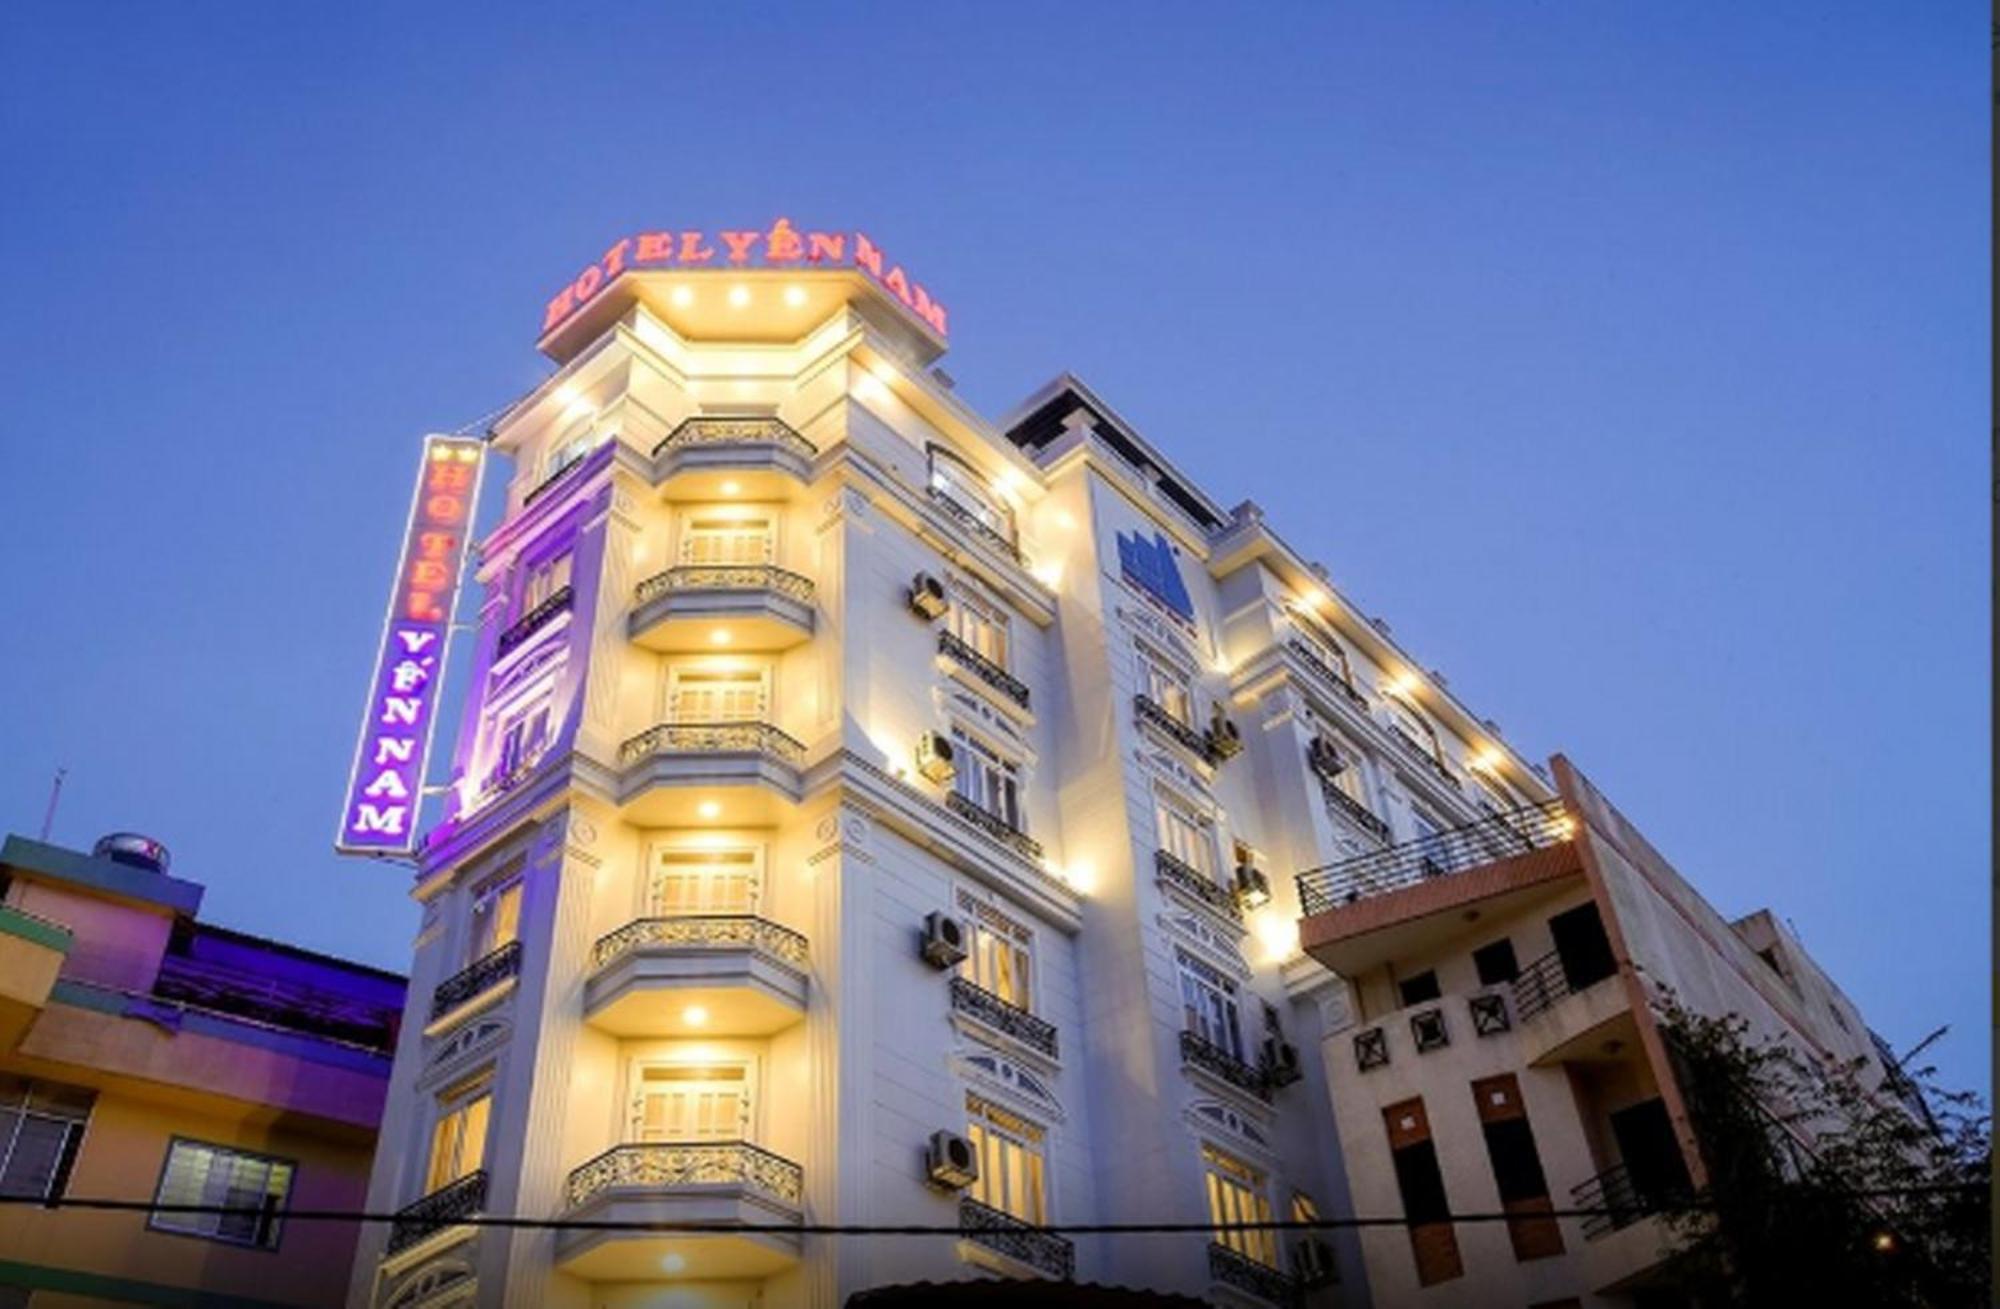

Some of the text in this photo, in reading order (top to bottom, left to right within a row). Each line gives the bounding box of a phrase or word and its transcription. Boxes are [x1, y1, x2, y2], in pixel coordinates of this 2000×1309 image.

[544, 230, 715, 330] HOTEL
[855, 231, 949, 337] NAM
[408, 462, 472, 621] HOTEL
[353, 736, 416, 835] NAM
